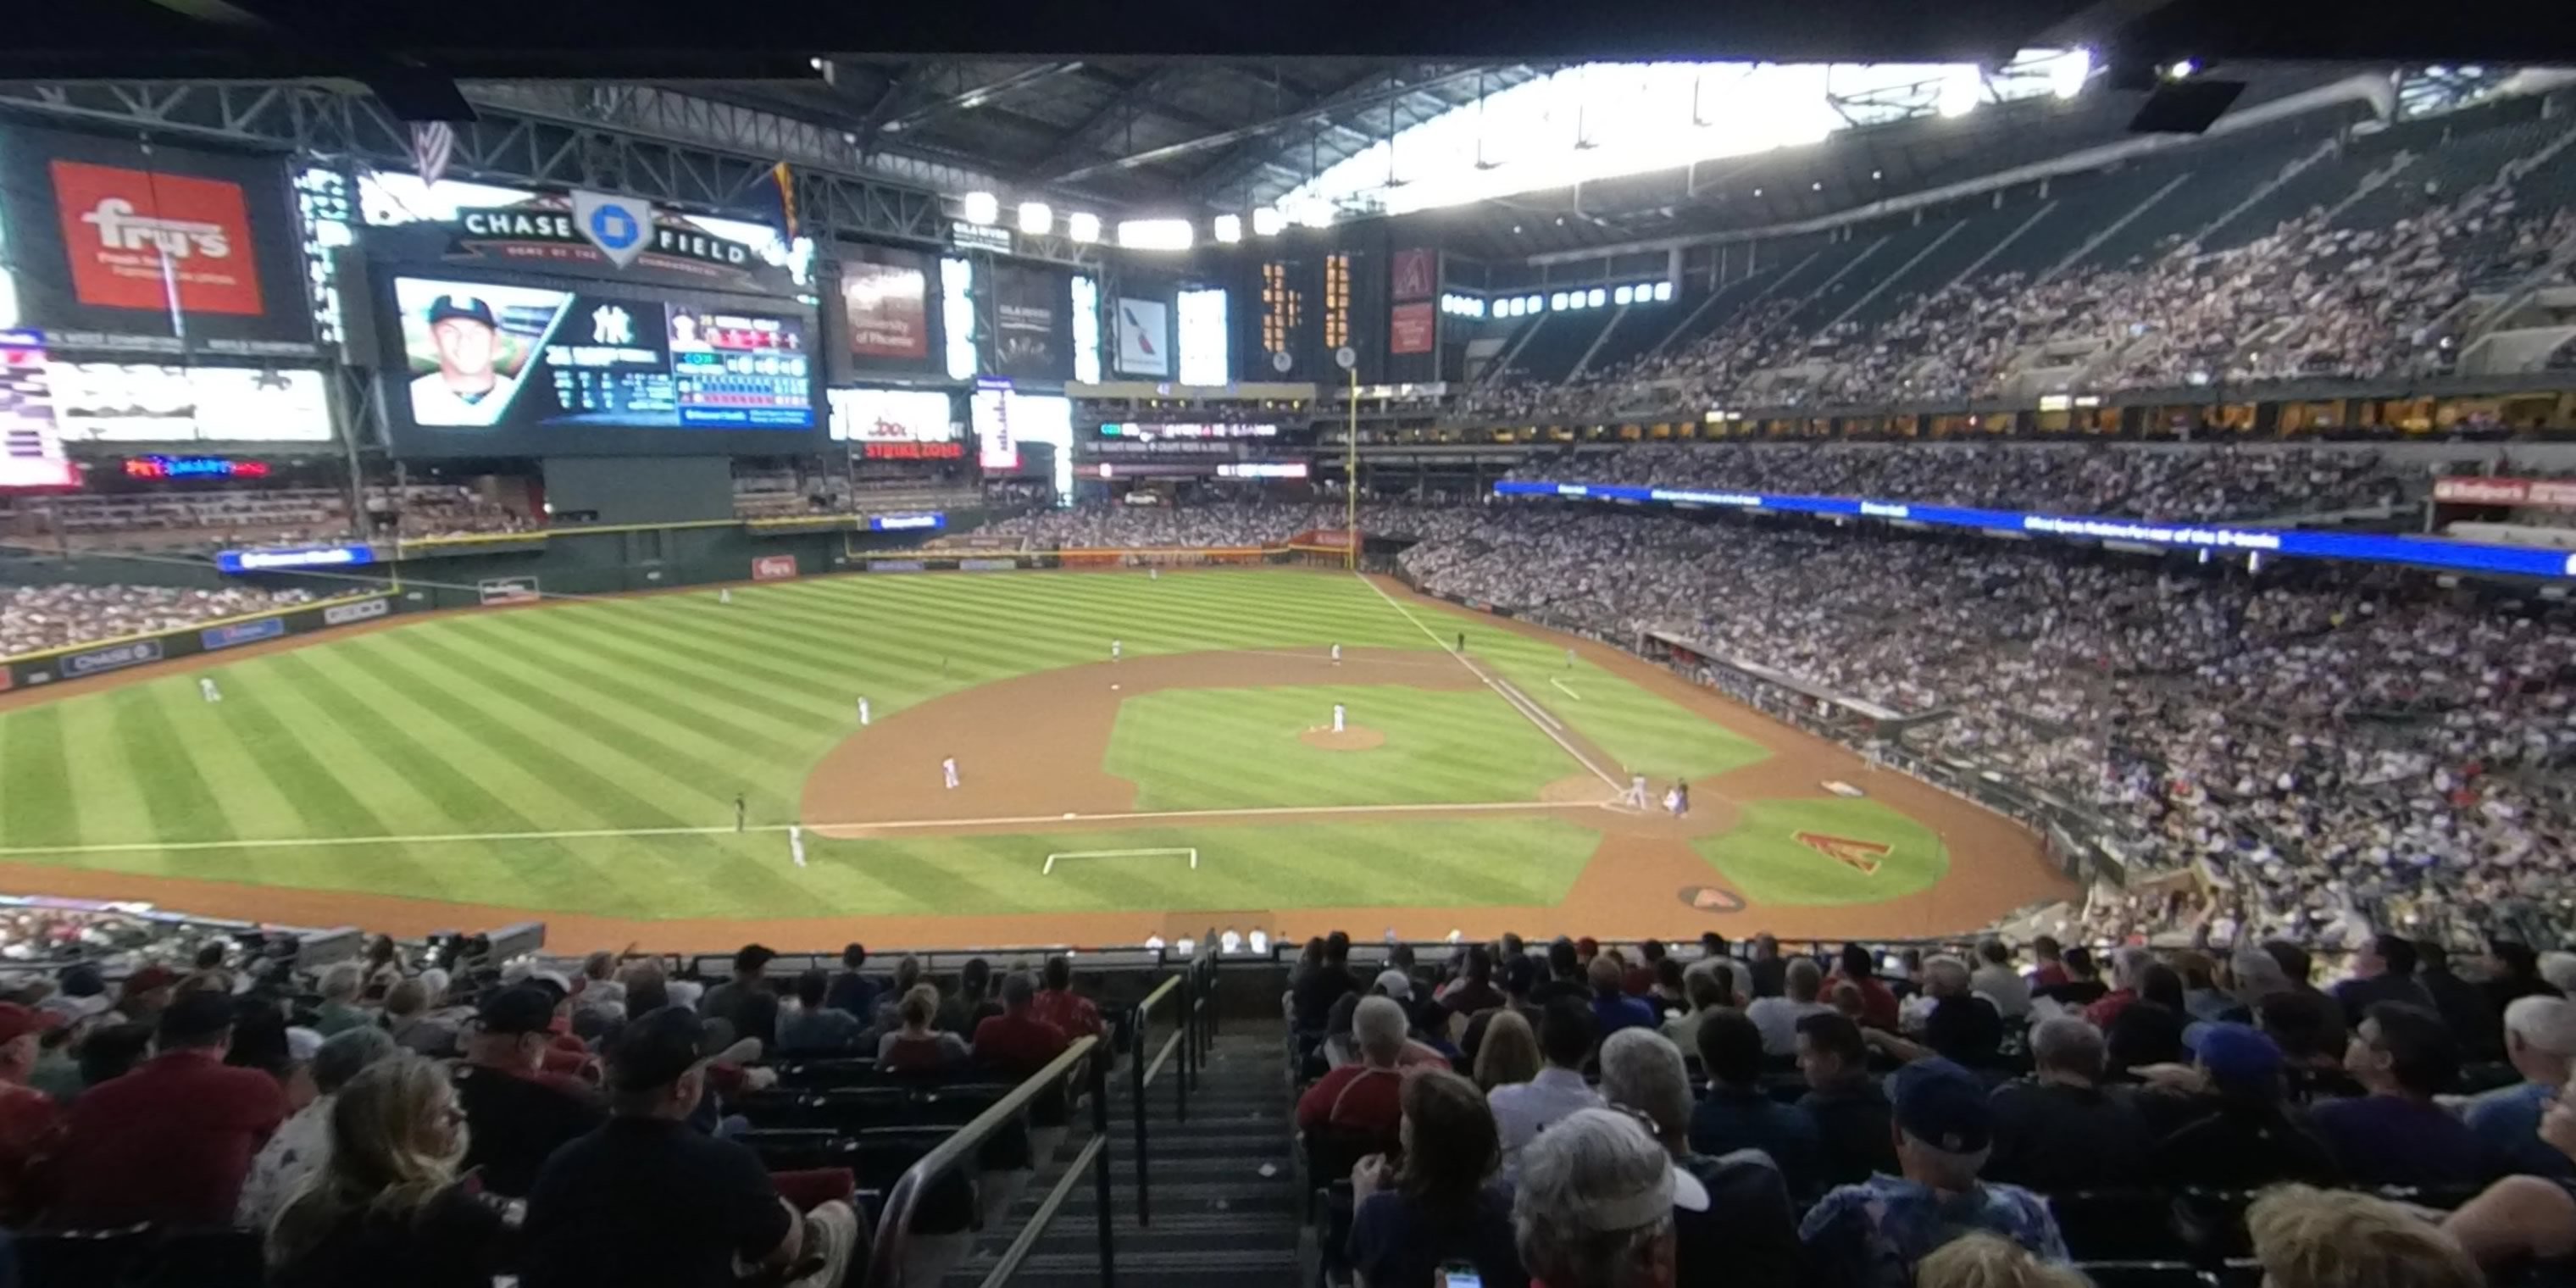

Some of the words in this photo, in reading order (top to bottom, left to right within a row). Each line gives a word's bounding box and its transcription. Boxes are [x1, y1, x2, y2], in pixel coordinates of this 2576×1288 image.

[81, 197, 230, 258] fry's
[465, 213, 572, 238] CHASE
[660, 230, 746, 263] FIELD
[867, 442, 918, 458] STRIKE
[920, 442, 963, 458] ZONE
